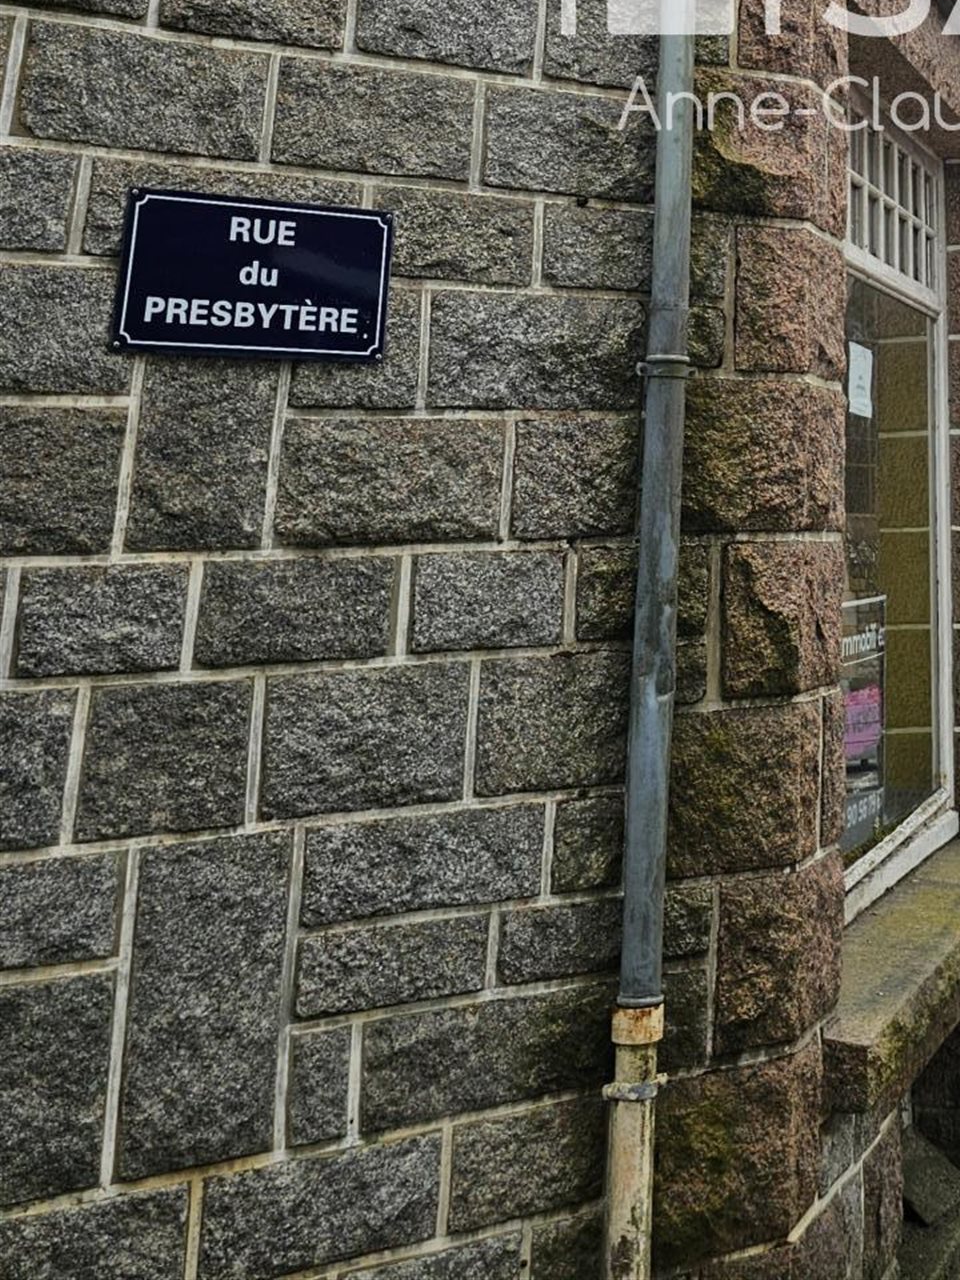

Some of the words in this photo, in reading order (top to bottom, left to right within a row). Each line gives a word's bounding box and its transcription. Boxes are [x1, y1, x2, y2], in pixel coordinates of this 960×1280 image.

[229, 216, 296, 246] RUE
[239, 261, 278, 287] du
[144, 296, 358, 333] PRESBYTÈRE
